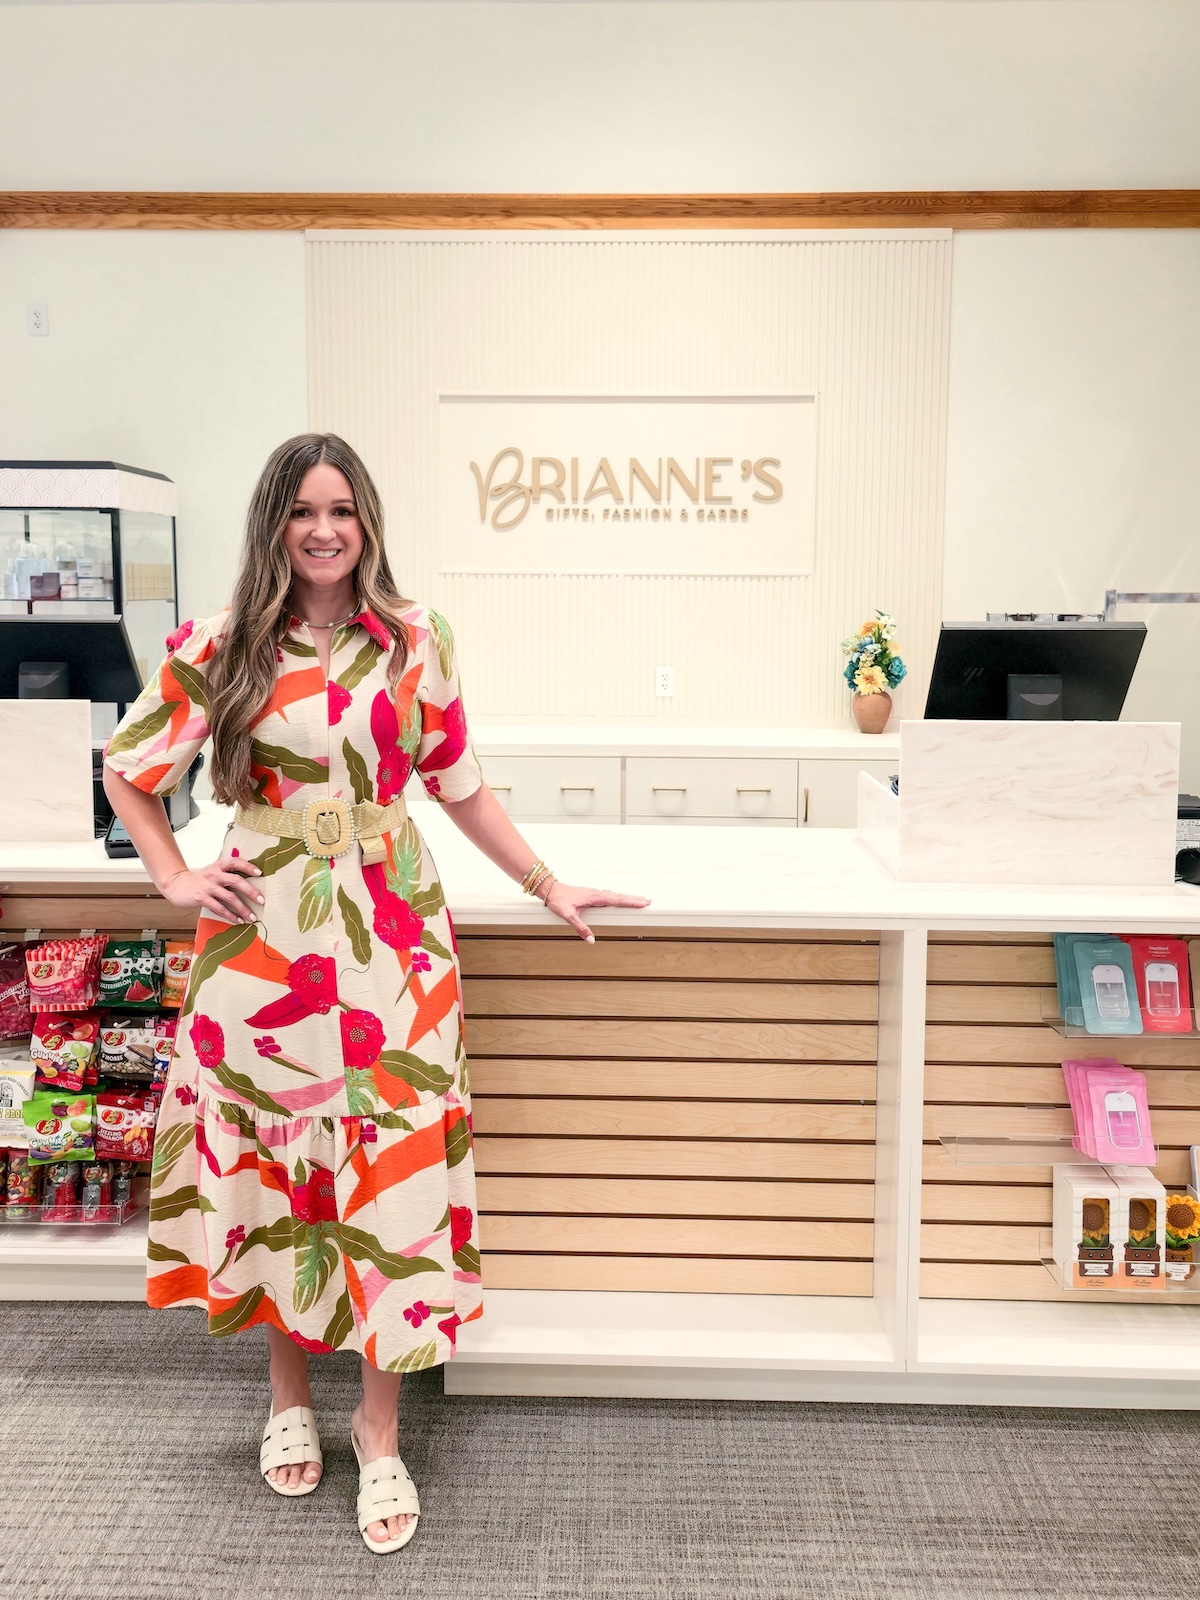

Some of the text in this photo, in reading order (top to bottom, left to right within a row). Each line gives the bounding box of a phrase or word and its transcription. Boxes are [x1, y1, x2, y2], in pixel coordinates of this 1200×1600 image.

[469, 446, 784, 531] BRIANNE'S
[545, 508, 750, 523] GIFTS, FASHION & CARDS
